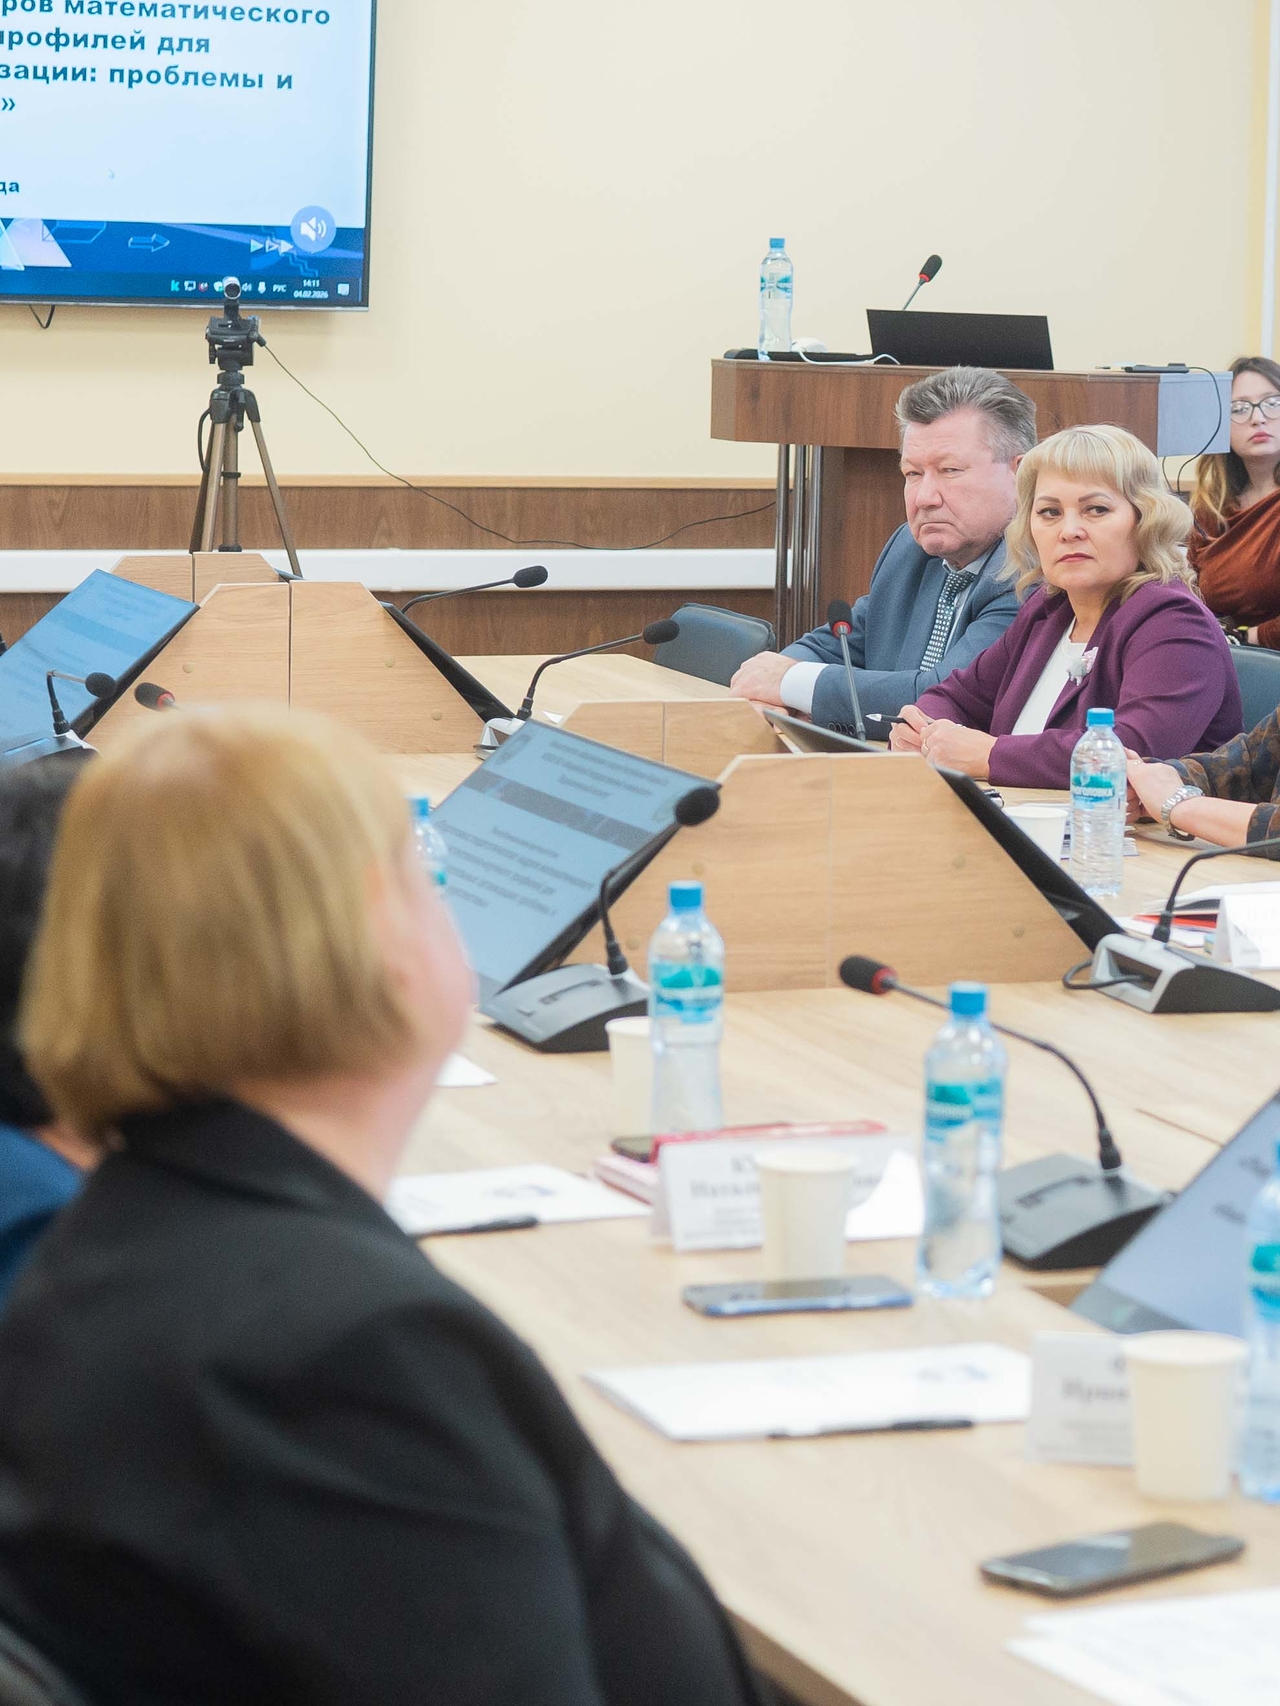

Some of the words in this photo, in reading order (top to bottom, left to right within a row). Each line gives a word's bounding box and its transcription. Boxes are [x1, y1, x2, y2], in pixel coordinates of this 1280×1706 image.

[64, 0, 330, 25] математического
[0, 27, 145, 52] рофилей
[157, 37, 210, 55] для
[109, 65, 263, 89] проблемы
[277, 74, 292, 89] и
[273, 284, 287, 293] РУС
